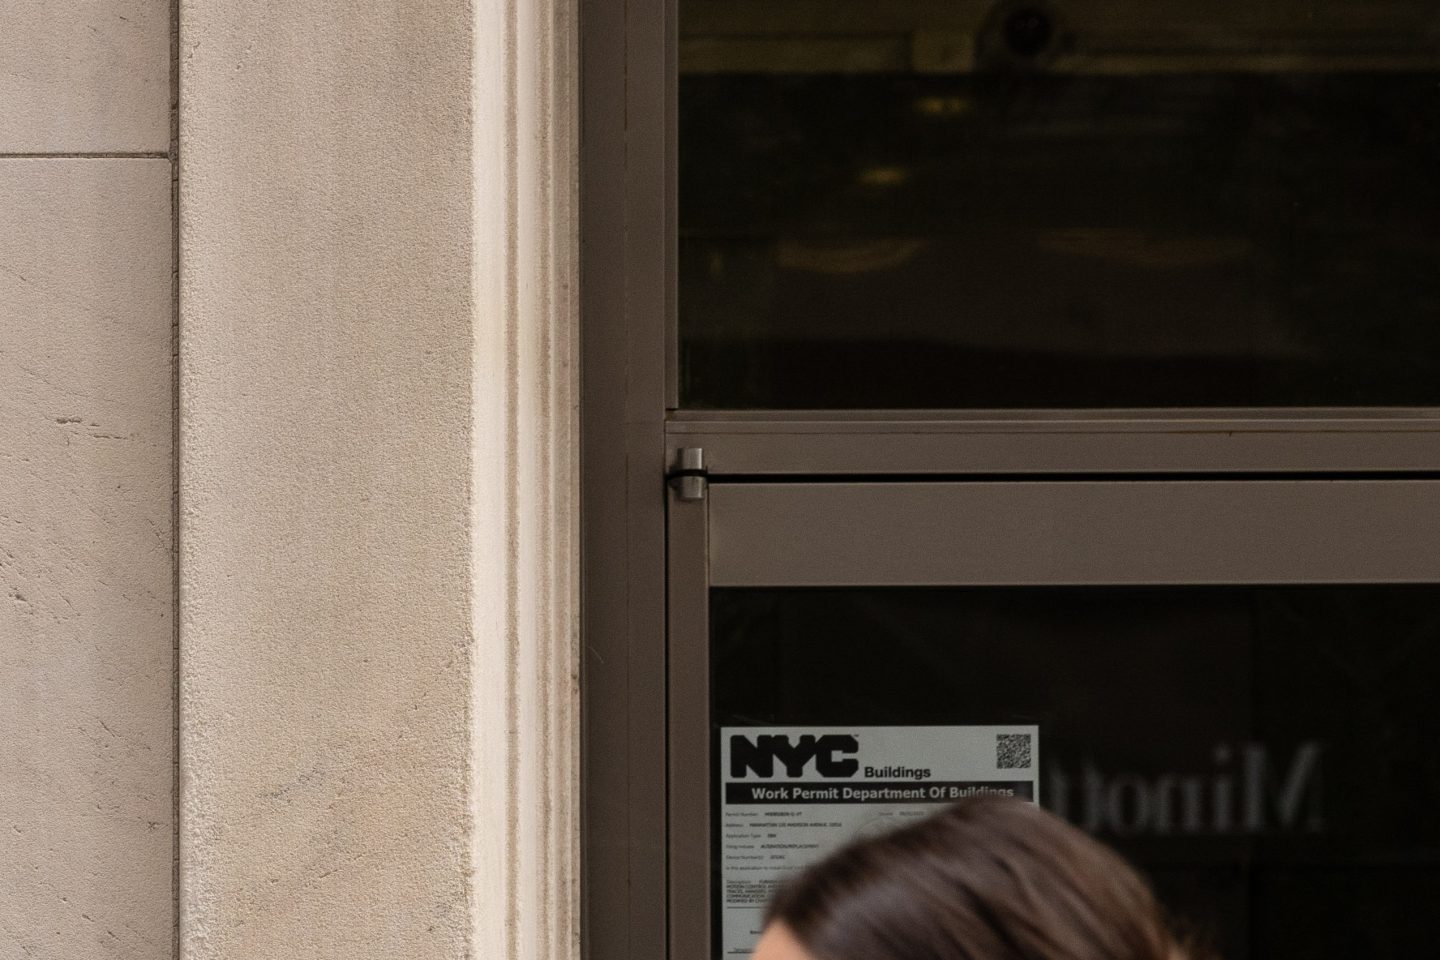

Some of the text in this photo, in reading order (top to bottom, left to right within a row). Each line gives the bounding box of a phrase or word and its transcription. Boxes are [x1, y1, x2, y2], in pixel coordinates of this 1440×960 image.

[729, 734, 859, 778] NYC
[863, 765, 932, 780] Buildings
[751, 787, 789, 800] Work
[792, 787, 839, 799] Permit
[842, 786, 928, 801] Department
[929, 786, 947, 799] Of
